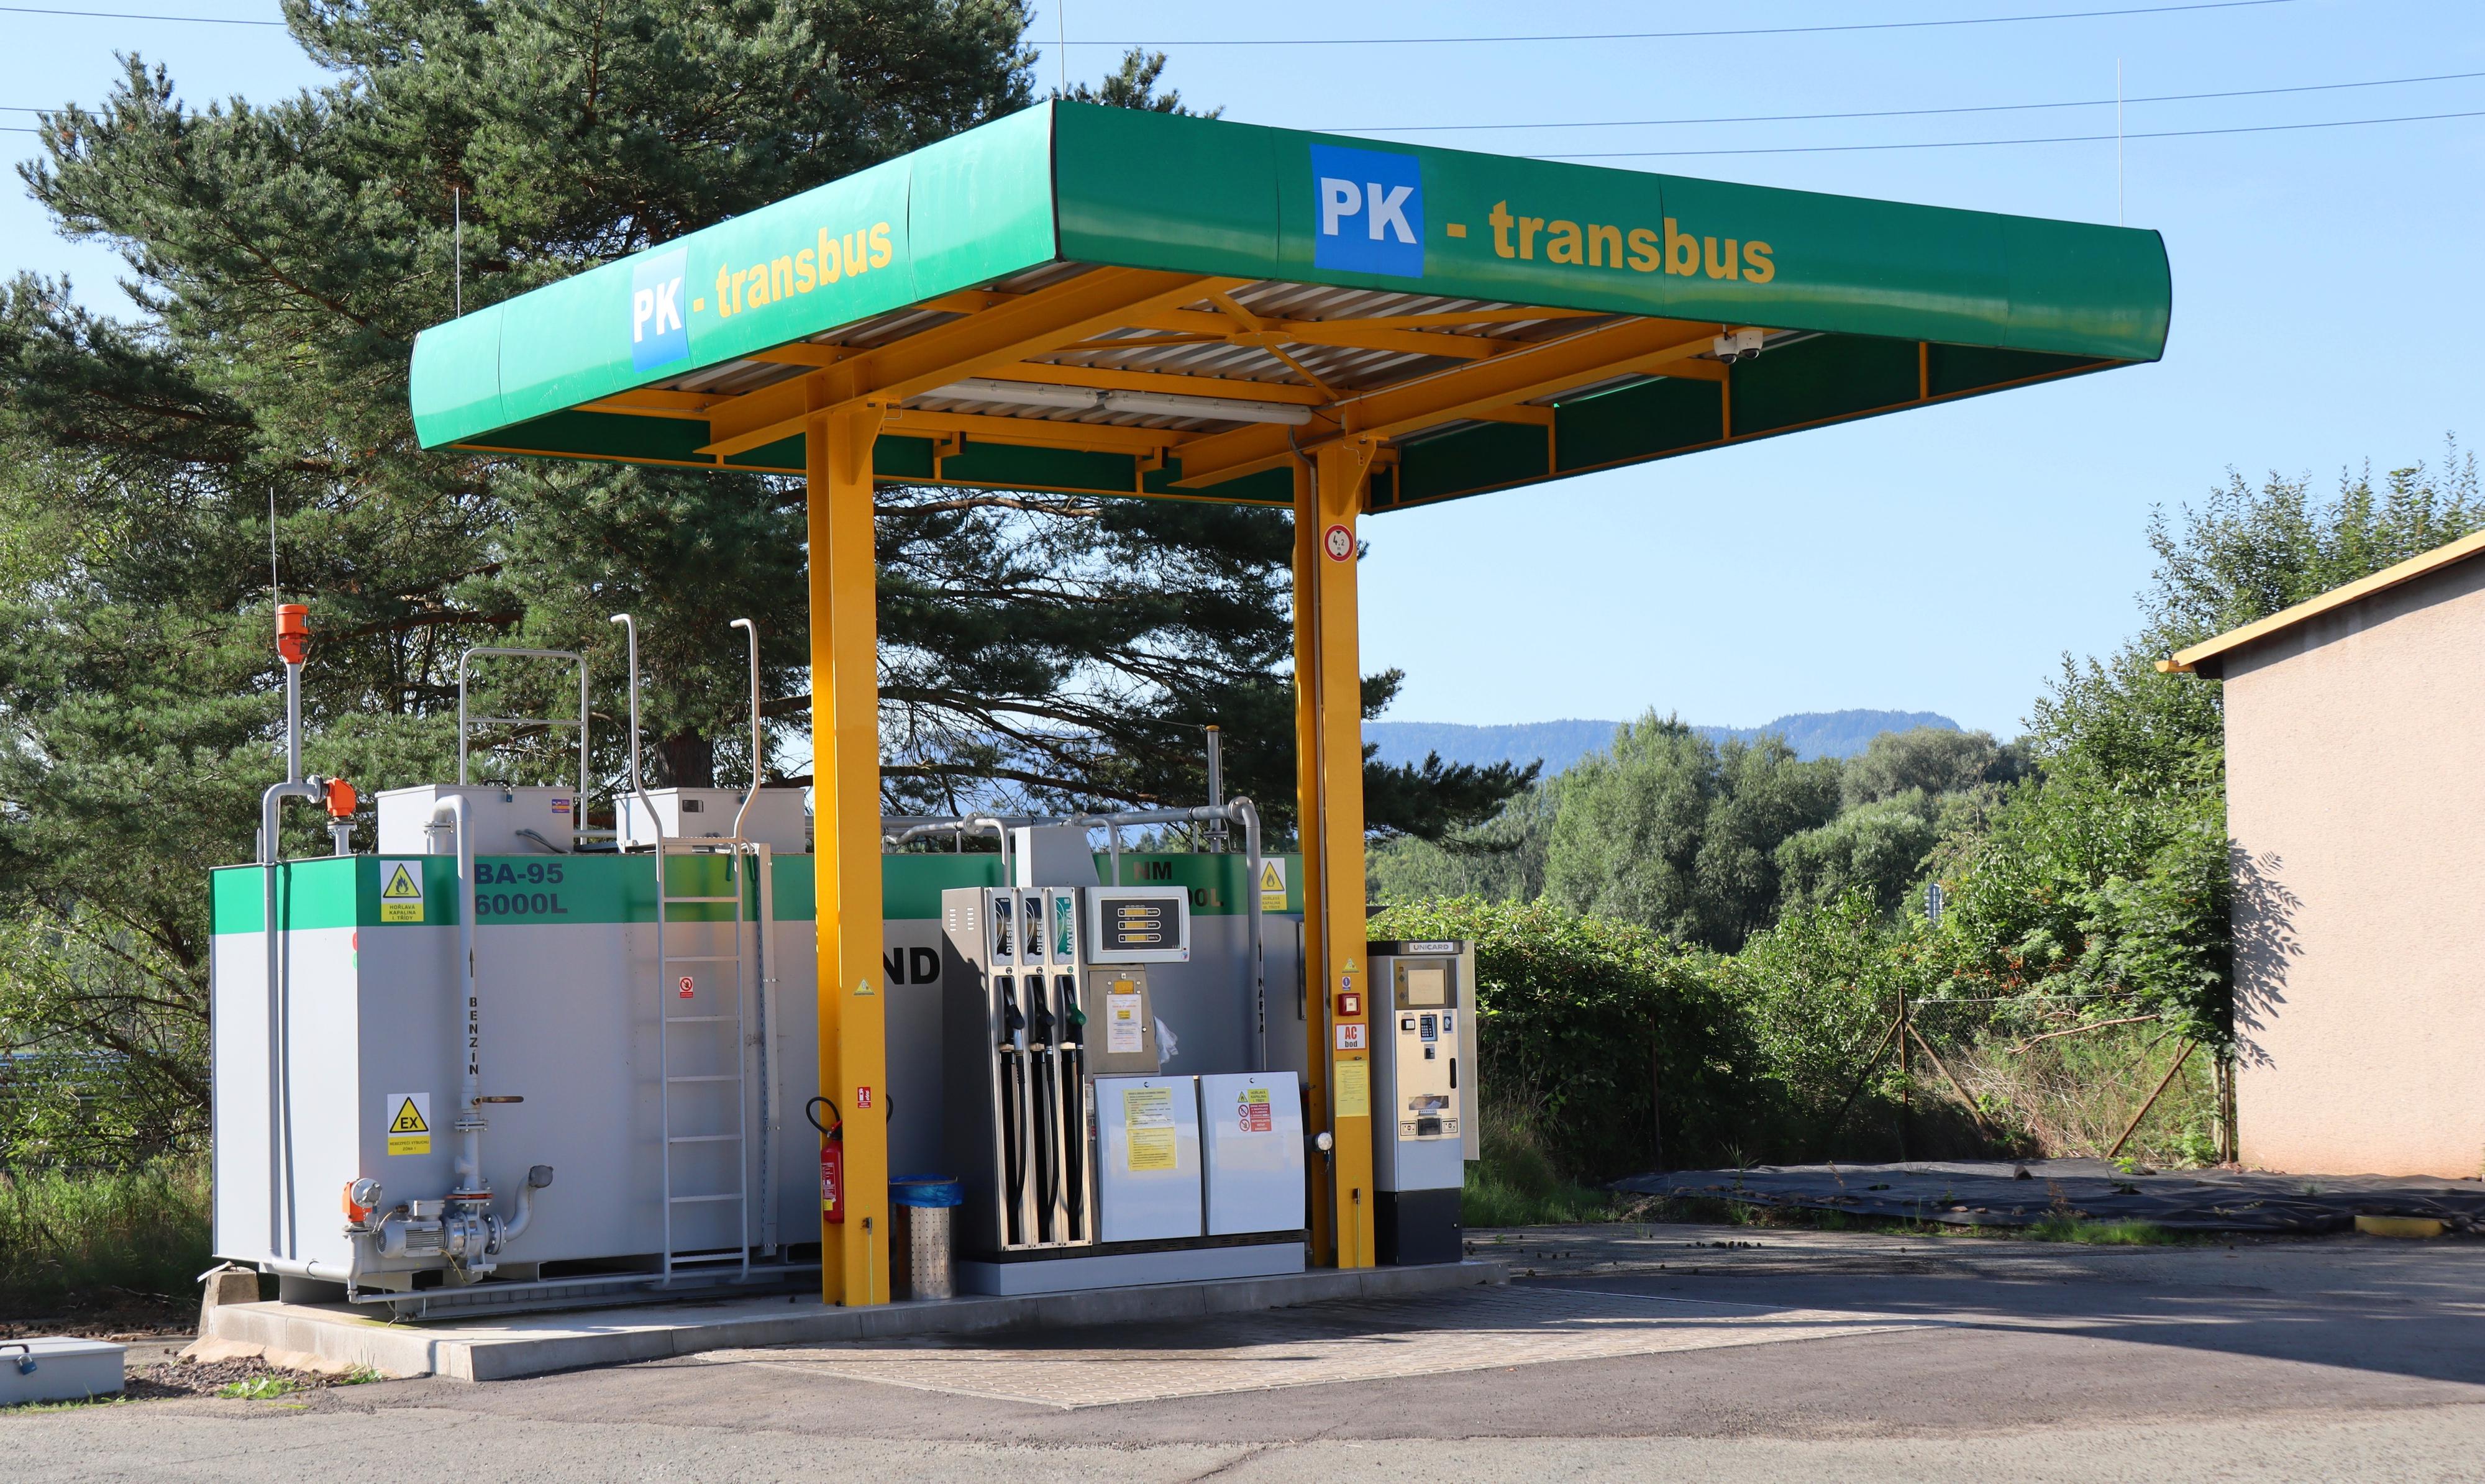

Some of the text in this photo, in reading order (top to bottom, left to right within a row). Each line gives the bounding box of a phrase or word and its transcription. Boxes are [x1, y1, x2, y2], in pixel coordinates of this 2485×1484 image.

[1320, 176, 1417, 244] PK
[1489, 199, 1776, 284] transbus
[633, 276, 682, 343] PK
[715, 221, 893, 319] transbus
[475, 863, 563, 885] BA-95
[1133, 861, 1172, 881] NM
[475, 893, 568, 916] 6000L
[469, 996, 478, 1075] BENZÍN
[1344, 1026, 1357, 1040] AC
[400, 1116, 418, 1129] EX
